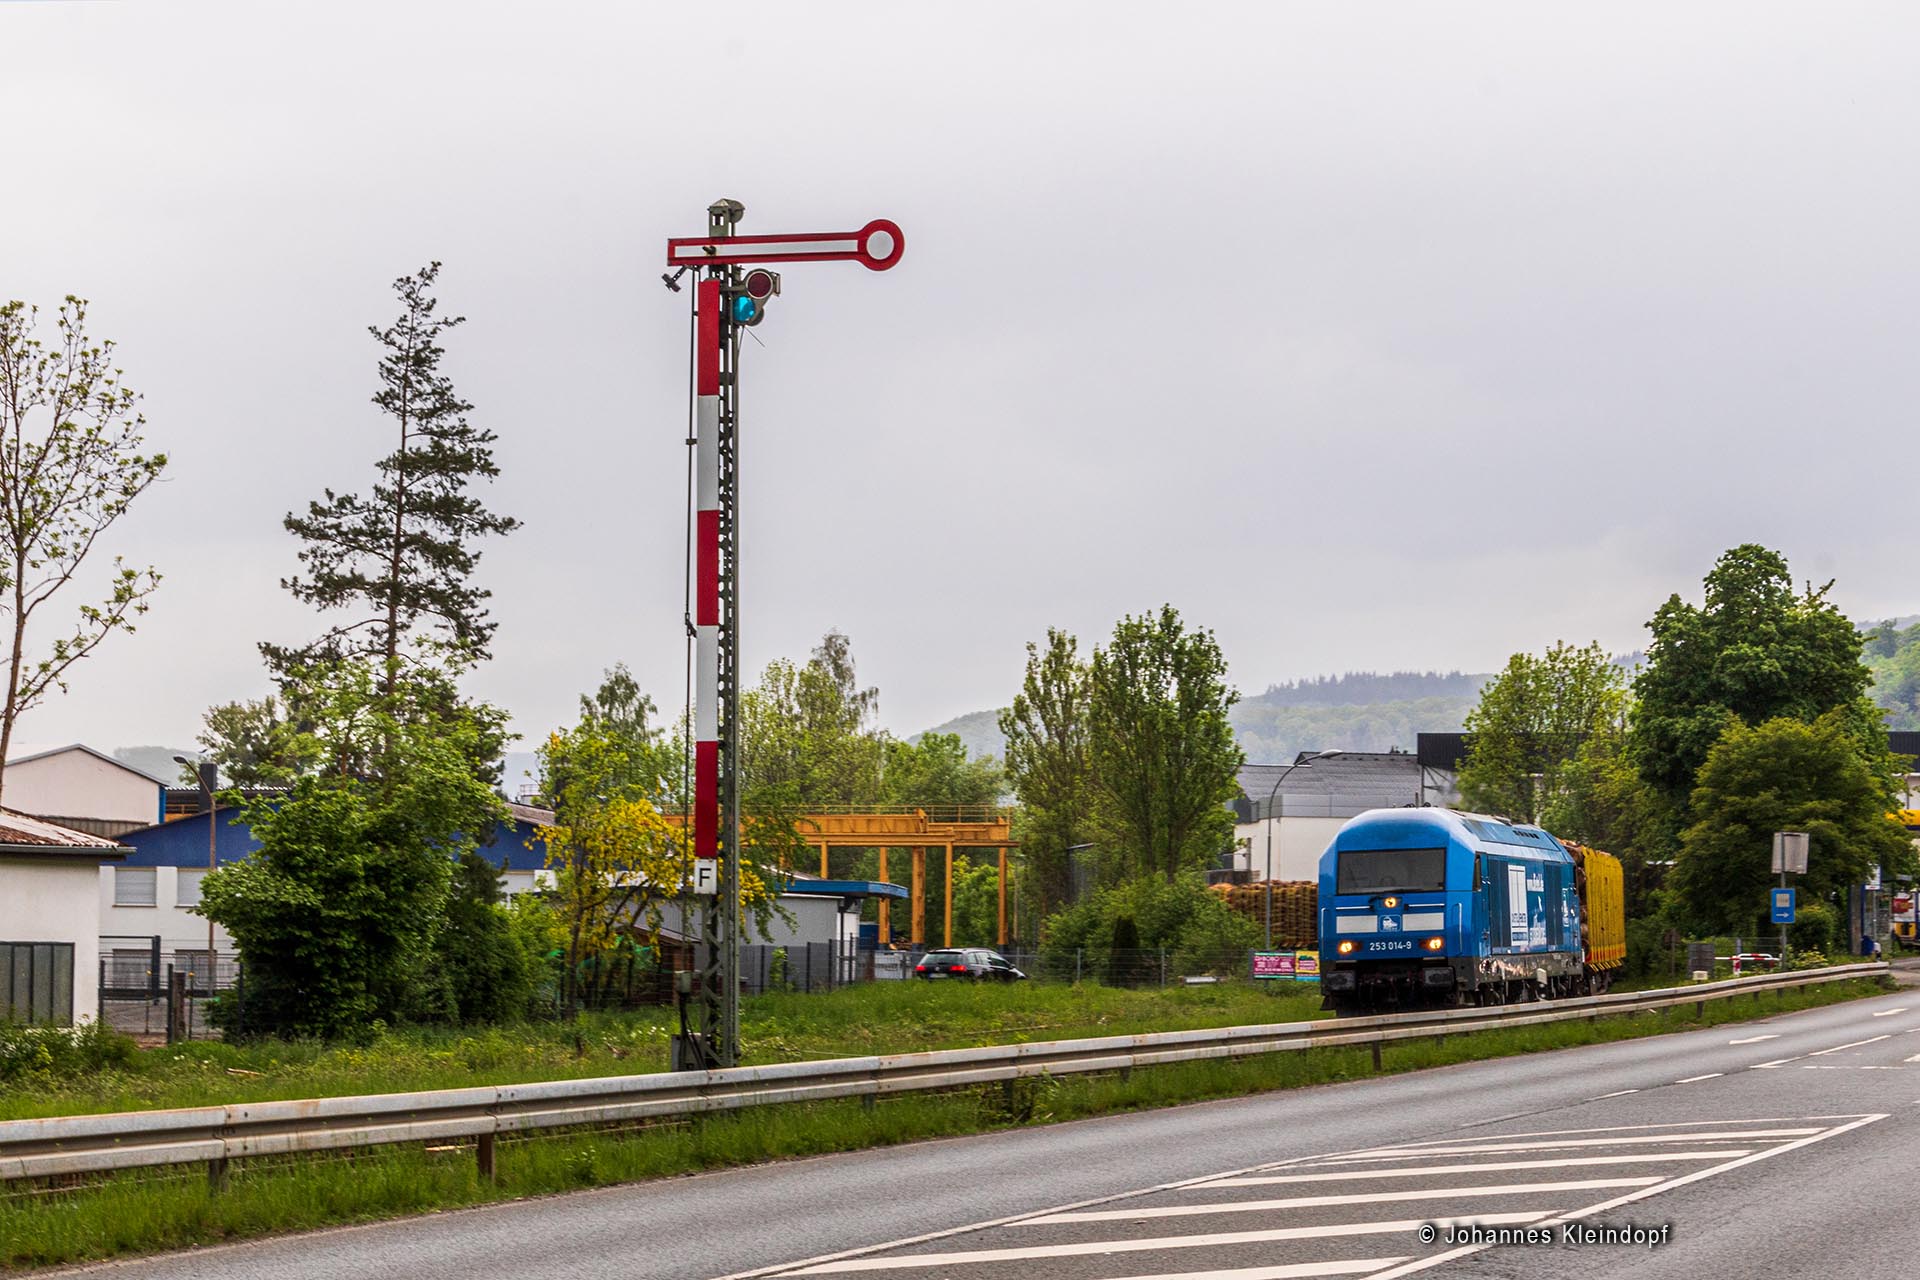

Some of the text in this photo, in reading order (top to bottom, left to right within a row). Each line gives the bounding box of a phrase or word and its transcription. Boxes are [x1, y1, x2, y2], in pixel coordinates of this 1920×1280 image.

[699, 868, 711, 887] F
[1369, 941, 1412, 951] 253 014-9
